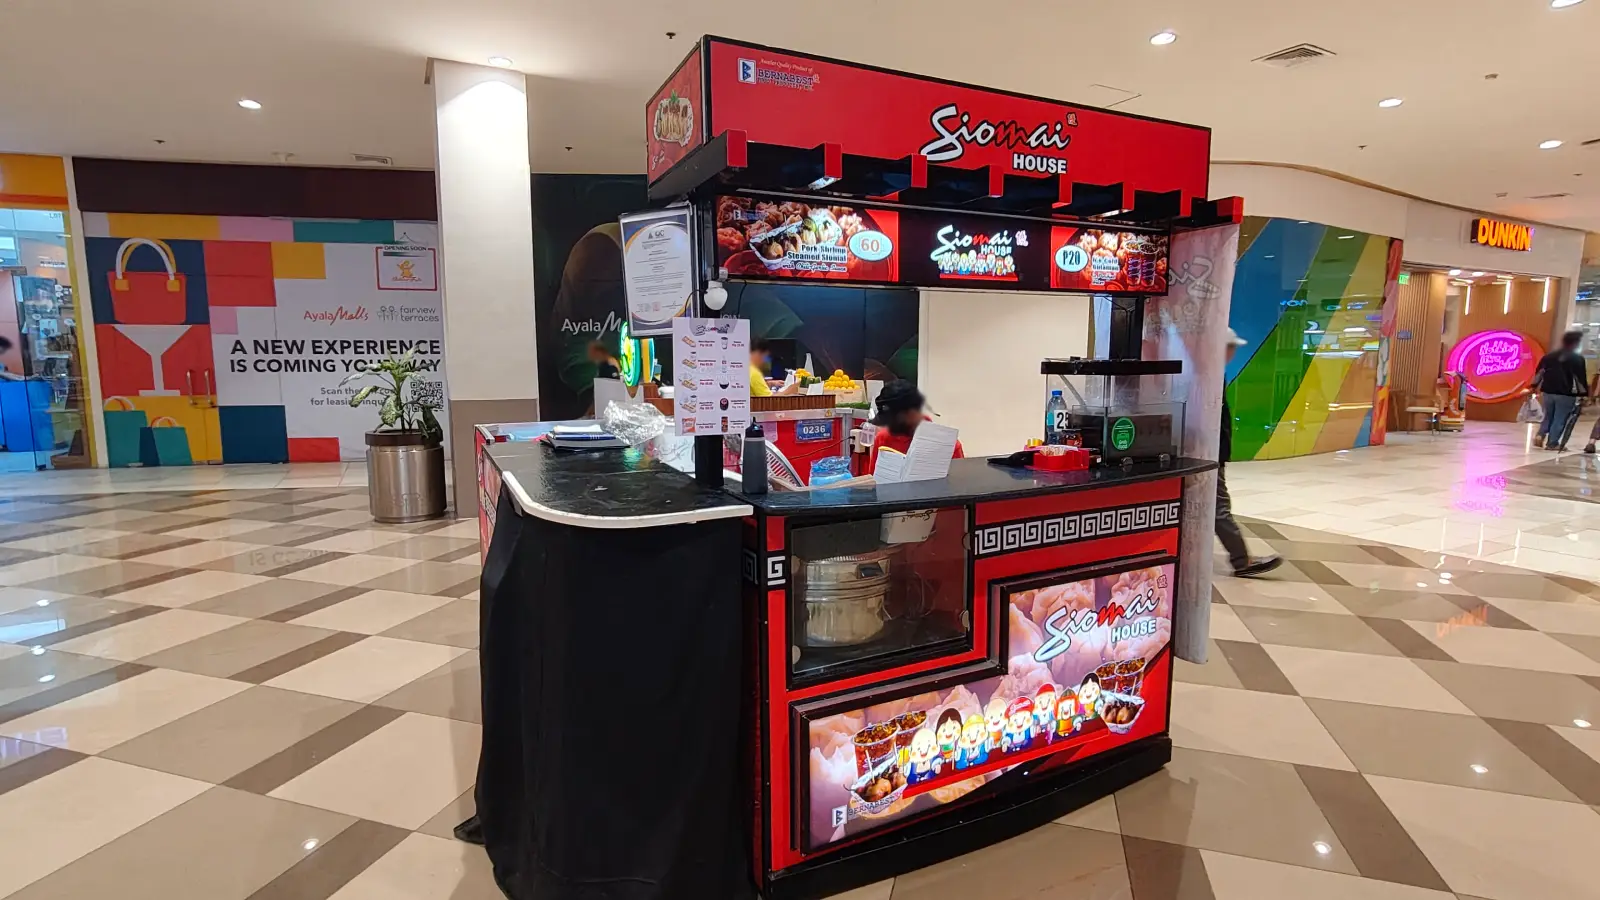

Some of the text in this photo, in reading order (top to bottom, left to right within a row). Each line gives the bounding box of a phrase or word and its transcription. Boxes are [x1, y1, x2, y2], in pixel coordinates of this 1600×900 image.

[757, 68, 814, 86] BERNABEST
[919, 103, 1071, 164] Siomai
[1012, 153, 1067, 175] HOUSE
[801, 244, 846, 254] Pork Shrimp
[861, 238, 880, 253] 60
[930, 224, 1013, 262] Siomai
[787, 251, 847, 262] Steamed Siomai
[303, 305, 369, 326] Ayala Malls
[400, 305, 436, 314] fairview
[400, 312, 440, 322] terraces
[561, 318, 601, 335] Ayala
[231, 339, 441, 355] A NEW EXPERIENCE
[230, 359, 248, 373] IS
[253, 359, 336, 373] COMING
[310, 398, 324, 406] for
[803, 426, 826, 434] 0236
[1033, 588, 1160, 663] Siomai
[1110, 618, 1157, 643] HOUSE
